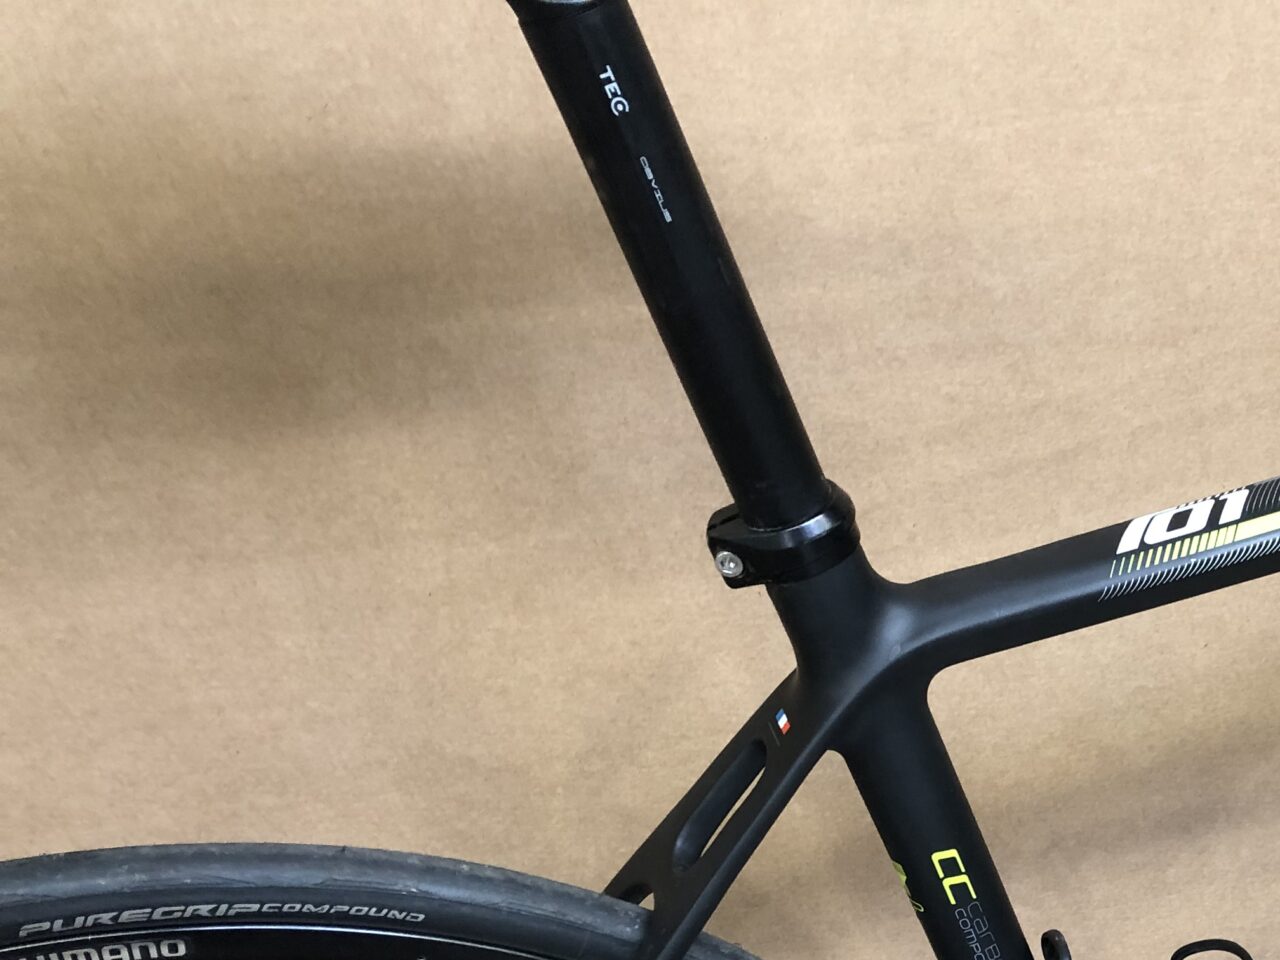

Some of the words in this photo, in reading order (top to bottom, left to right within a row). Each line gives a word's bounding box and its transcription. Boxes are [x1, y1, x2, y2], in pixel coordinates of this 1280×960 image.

[599, 65, 630, 116] TEC
[1116, 488, 1250, 555] 101
[18, 903, 262, 938] PUREGRIP
[261, 902, 426, 923] COMPOUND
